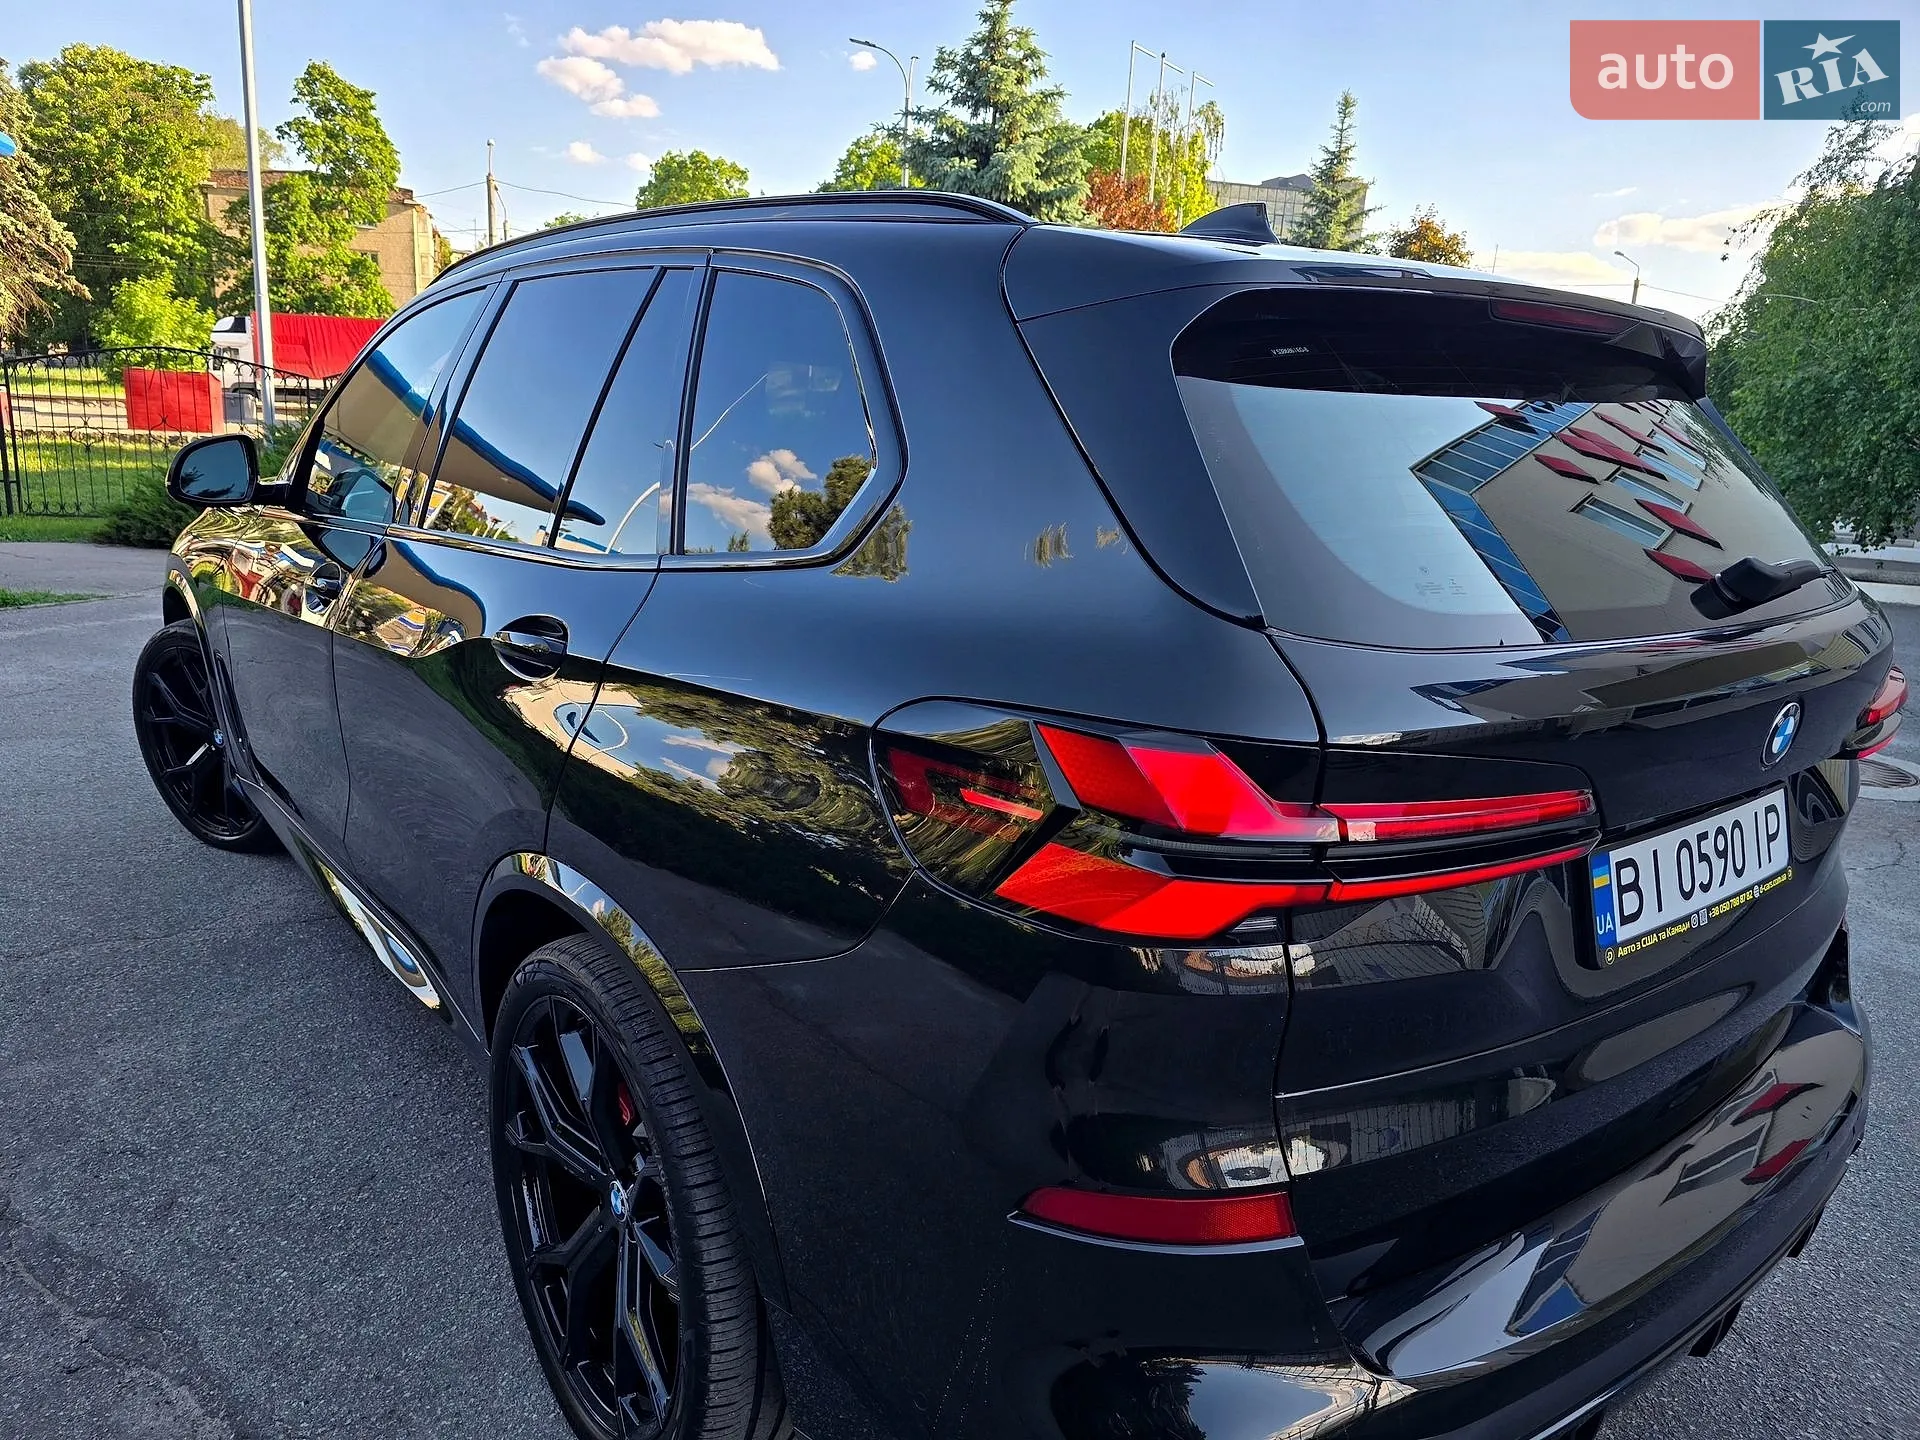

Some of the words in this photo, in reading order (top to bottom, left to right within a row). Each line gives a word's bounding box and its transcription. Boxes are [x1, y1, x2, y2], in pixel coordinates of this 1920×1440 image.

[1614, 848, 1664, 927] BI
[1675, 819, 1746, 901] 0590
[1754, 803, 1781, 870] IP
[1596, 912, 1614, 935] UA
[1617, 946, 1636, 958] Авто
[1641, 933, 1659, 948] США
[1658, 931, 1667, 941] та
[1666, 921, 1691, 938] Канади
